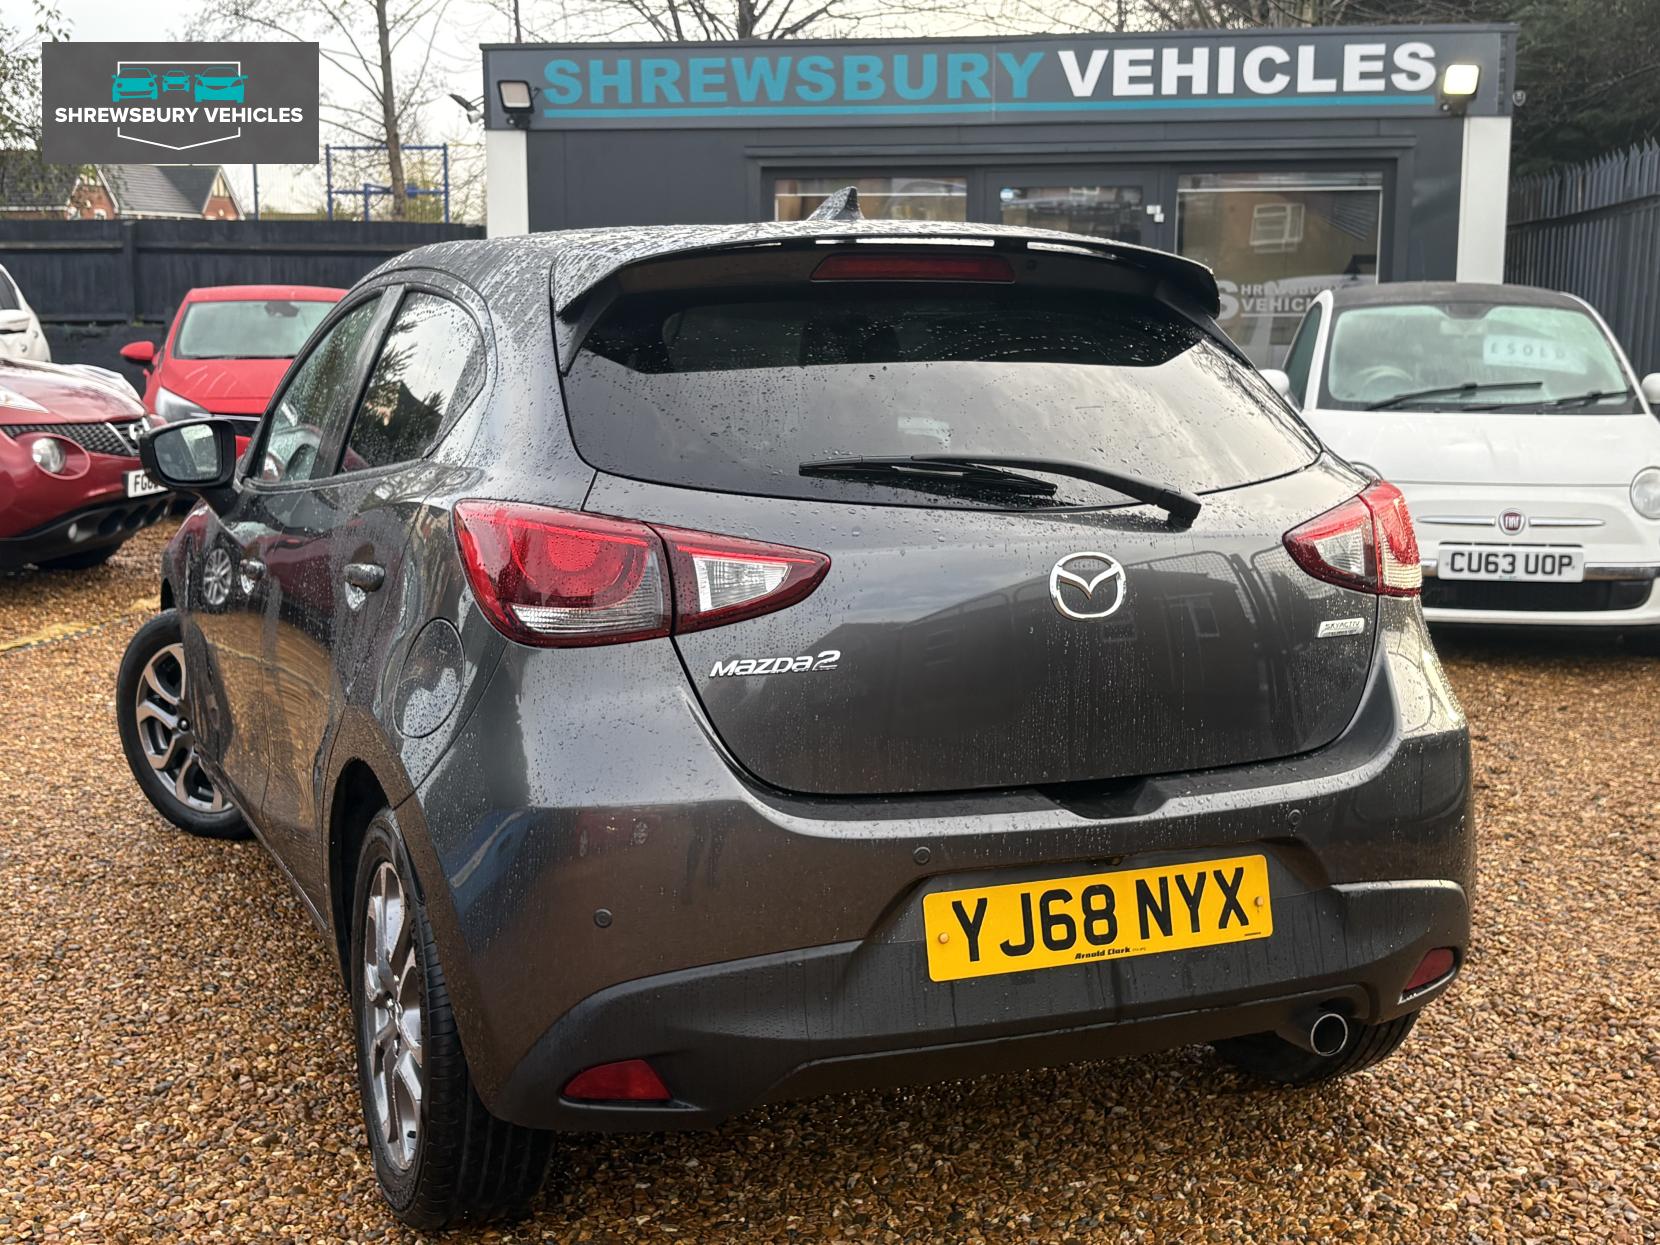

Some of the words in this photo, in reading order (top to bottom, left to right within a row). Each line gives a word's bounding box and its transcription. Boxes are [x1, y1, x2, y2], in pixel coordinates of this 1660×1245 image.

[543, 51, 1045, 105] SHREWSBURY
[1057, 41, 1437, 97] VEHICLES
[1450, 552, 1517, 575] CU63
[1524, 553, 1573, 576] UOP
[951, 883, 1117, 962] YJ68
[1134, 866, 1250, 941] NYX
[1074, 949, 1106, 960] Arnold
[1107, 946, 1131, 956] Clark
